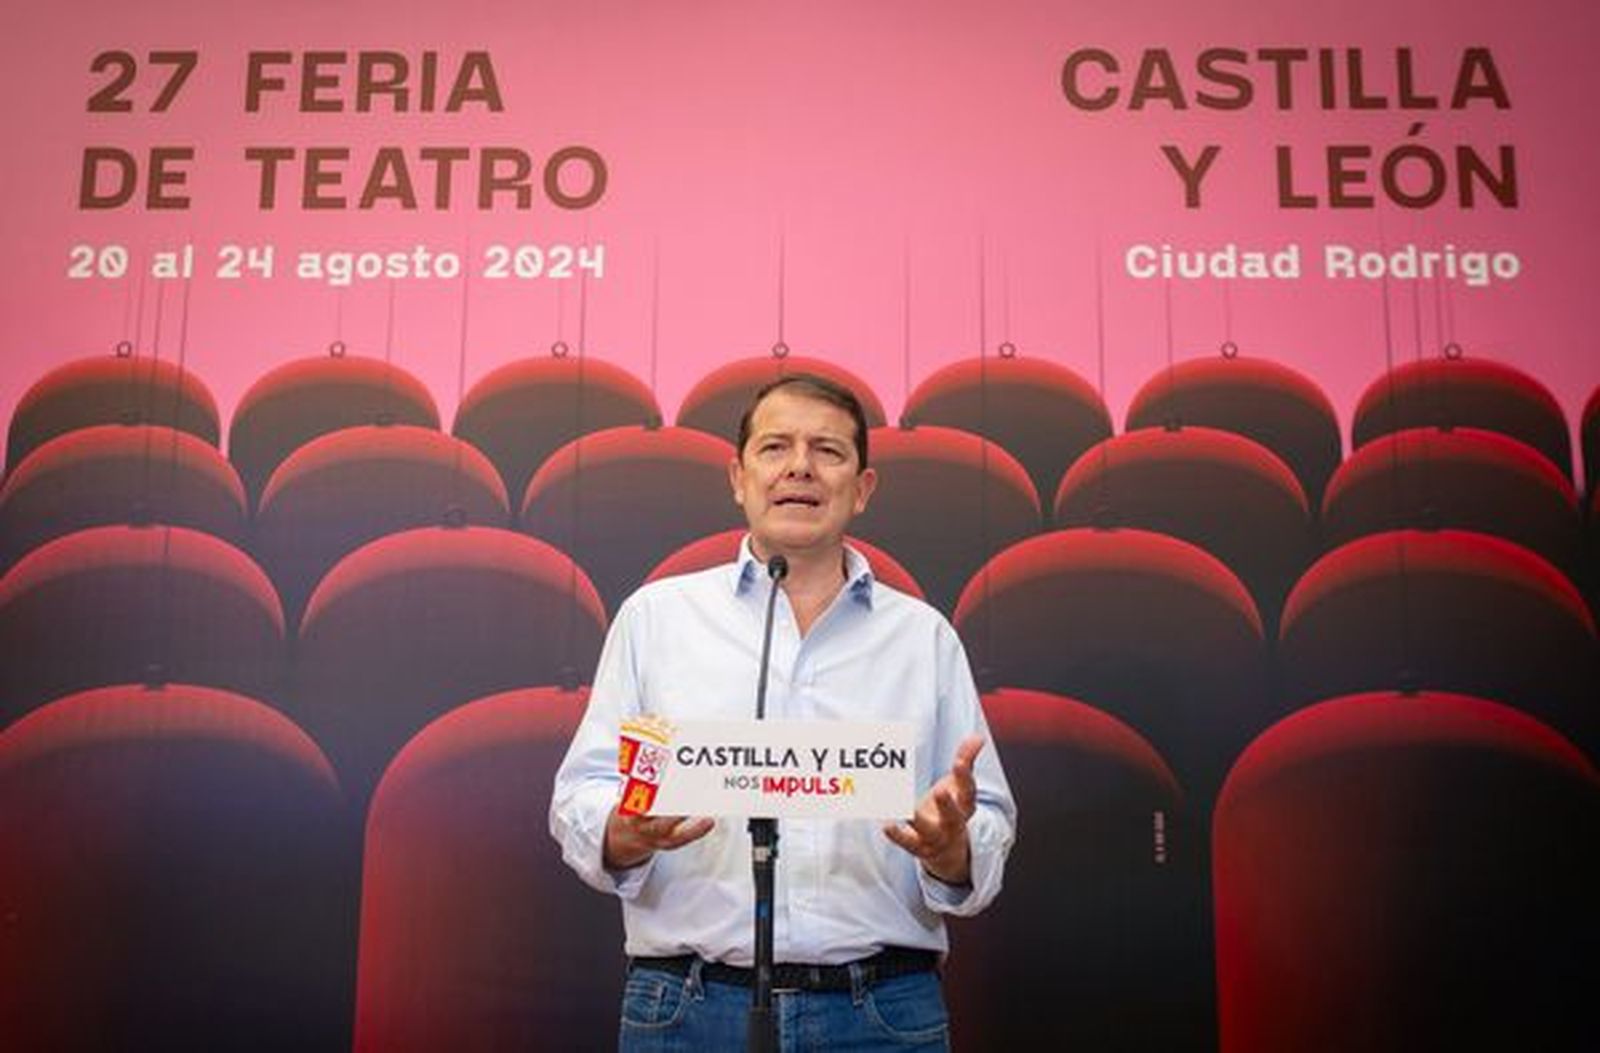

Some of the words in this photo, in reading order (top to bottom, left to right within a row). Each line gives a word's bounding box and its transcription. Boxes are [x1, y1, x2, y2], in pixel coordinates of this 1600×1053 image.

[86, 50, 198, 113] 27
[244, 50, 504, 113] FERIA
[1060, 47, 1511, 111] CASTILLA
[78, 147, 195, 210] DE
[244, 146, 609, 211] TEATRO
[1161, 145, 1221, 208] Y
[1275, 122, 1519, 209] LEÓN
[67, 245, 129, 279] 20
[151, 245, 193, 279] al
[216, 245, 273, 279] 24
[297, 245, 460, 286] agosto
[484, 245, 605, 279] 2024
[1125, 244, 1300, 279] Ciudad
[1325, 244, 1521, 286] Rodrigo
[676, 746, 799, 767] CASTILLA
[812, 749, 829, 771] Y
[839, 743, 906, 768] LEÓN
[724, 776, 760, 790] NOS
